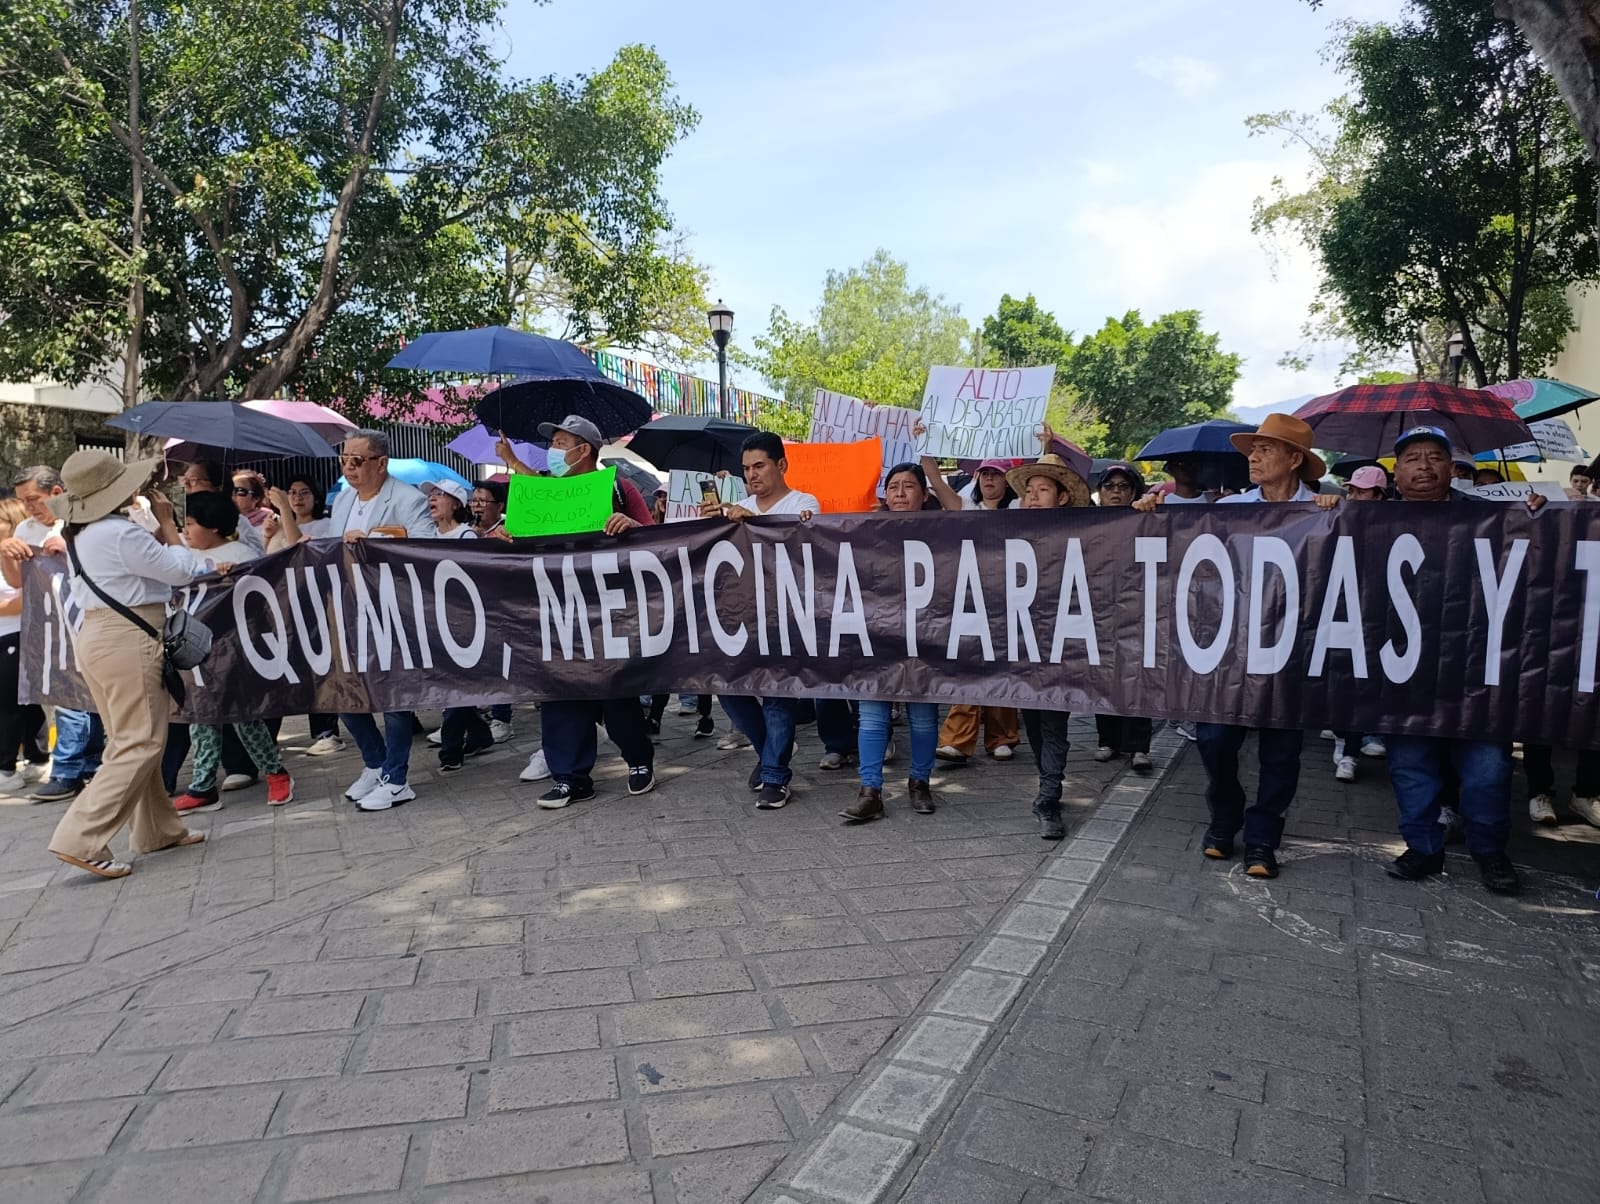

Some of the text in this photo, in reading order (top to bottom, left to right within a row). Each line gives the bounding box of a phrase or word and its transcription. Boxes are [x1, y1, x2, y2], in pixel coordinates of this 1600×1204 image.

[957, 369, 1022, 400] ALTO
[813, 389, 831, 423] EN
[834, 396, 855, 432] LA
[920, 395, 1047, 429] AL DESABASTO
[914, 423, 932, 455] DE
[513, 482, 593, 504] QUEREMOS
[1476, 485, 1535, 497] Salud
[523, 503, 593, 525] SALUD!
[232, 559, 512, 684] QUIMIO,
[533, 541, 873, 662] MEDICINA
[904, 538, 1101, 665] PARA
[1135, 533, 1424, 684] TODAS
[1475, 539, 1529, 686] Y
